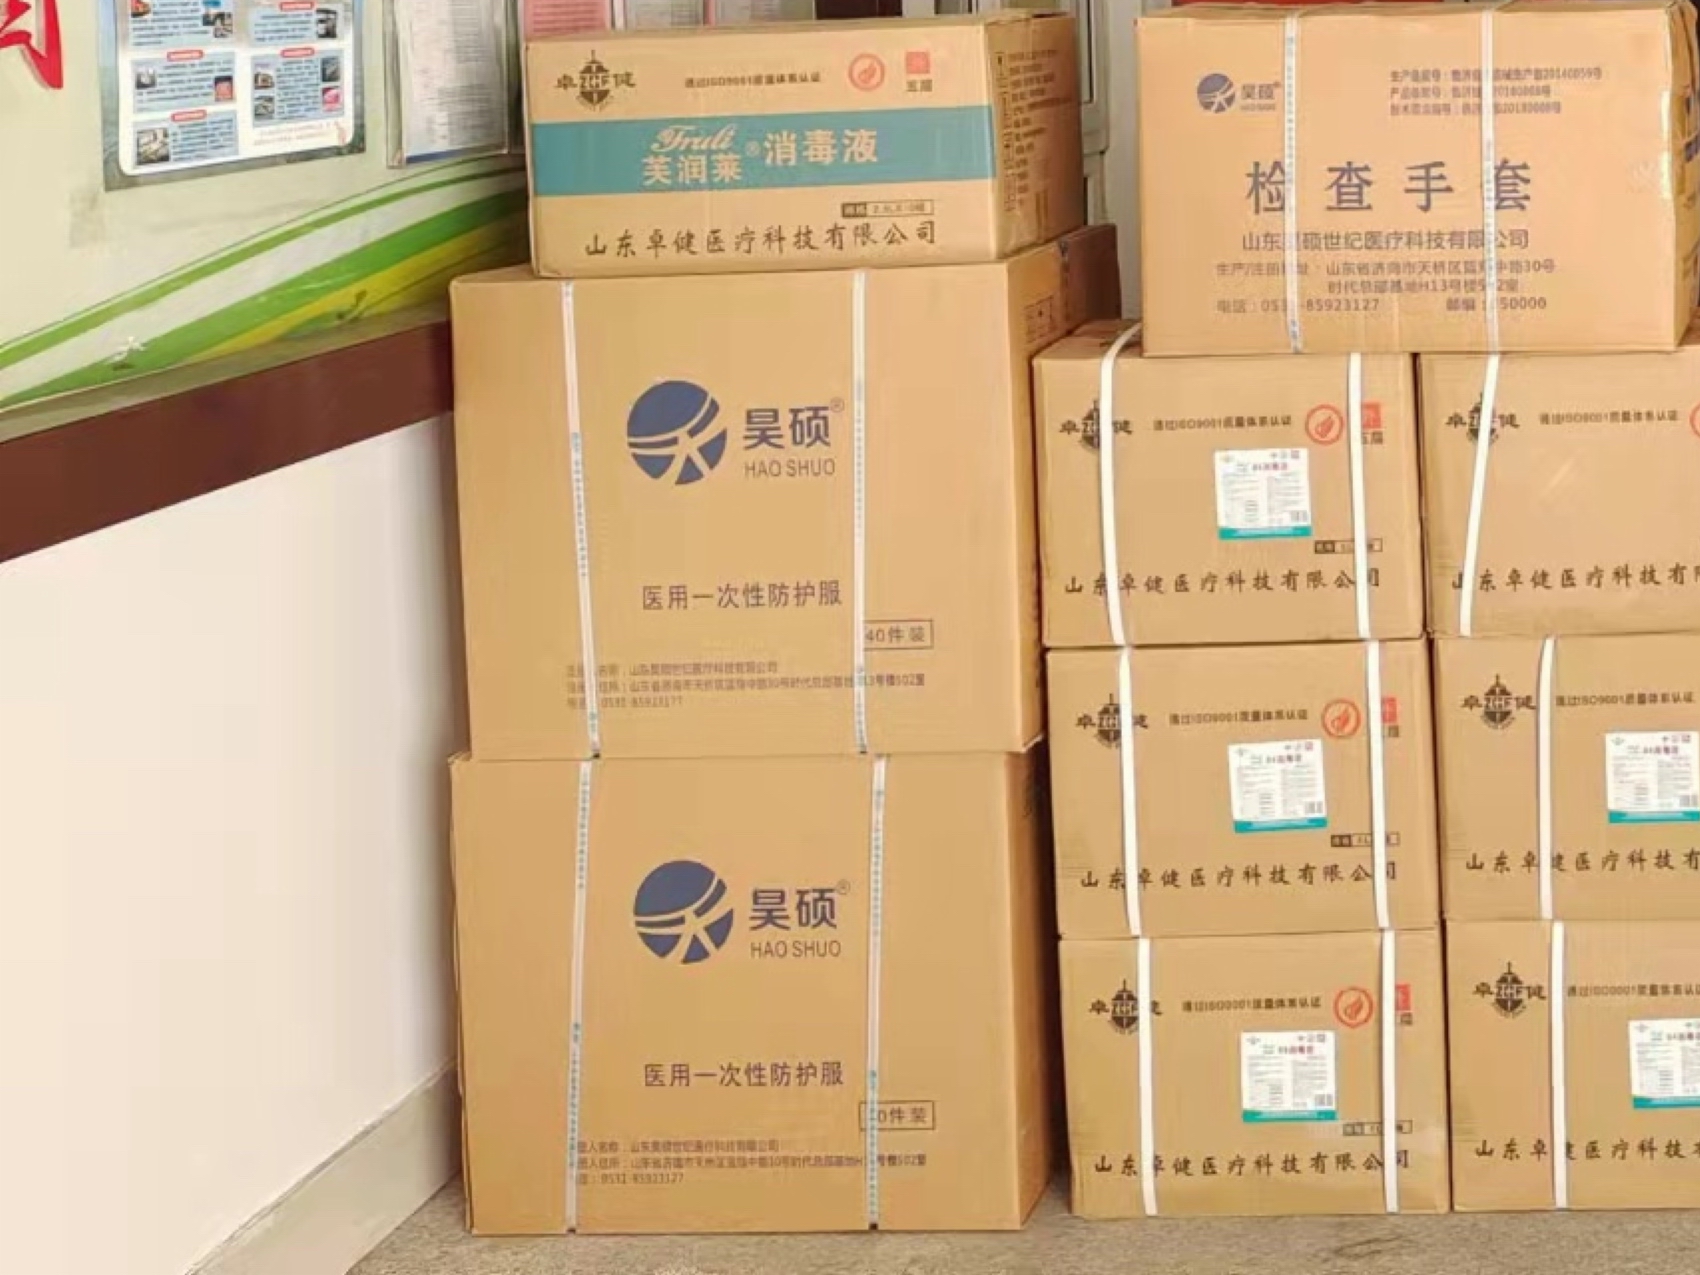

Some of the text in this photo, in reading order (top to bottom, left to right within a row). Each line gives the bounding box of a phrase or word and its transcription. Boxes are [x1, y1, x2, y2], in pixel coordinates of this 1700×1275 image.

[641, 128, 879, 187] 芙润莱 消毒液
[1245, 159, 1533, 215] 检查手套
[585, 219, 937, 259] 山东卓健医疗科技有限公司
[1242, 229, 1529, 251] 山东硕世纪医疗科技有限公司
[742, 405, 832, 450] 昊硕
[744, 457, 837, 478] HAO SHUO
[641, 579, 844, 612] 医用一次性防护服
[748, 887, 838, 932] 昊硕
[750, 940, 842, 959] HAO SHUO
[643, 1061, 844, 1088] 医用一次性防护服
[874, 1106, 928, 1124] 0件装
